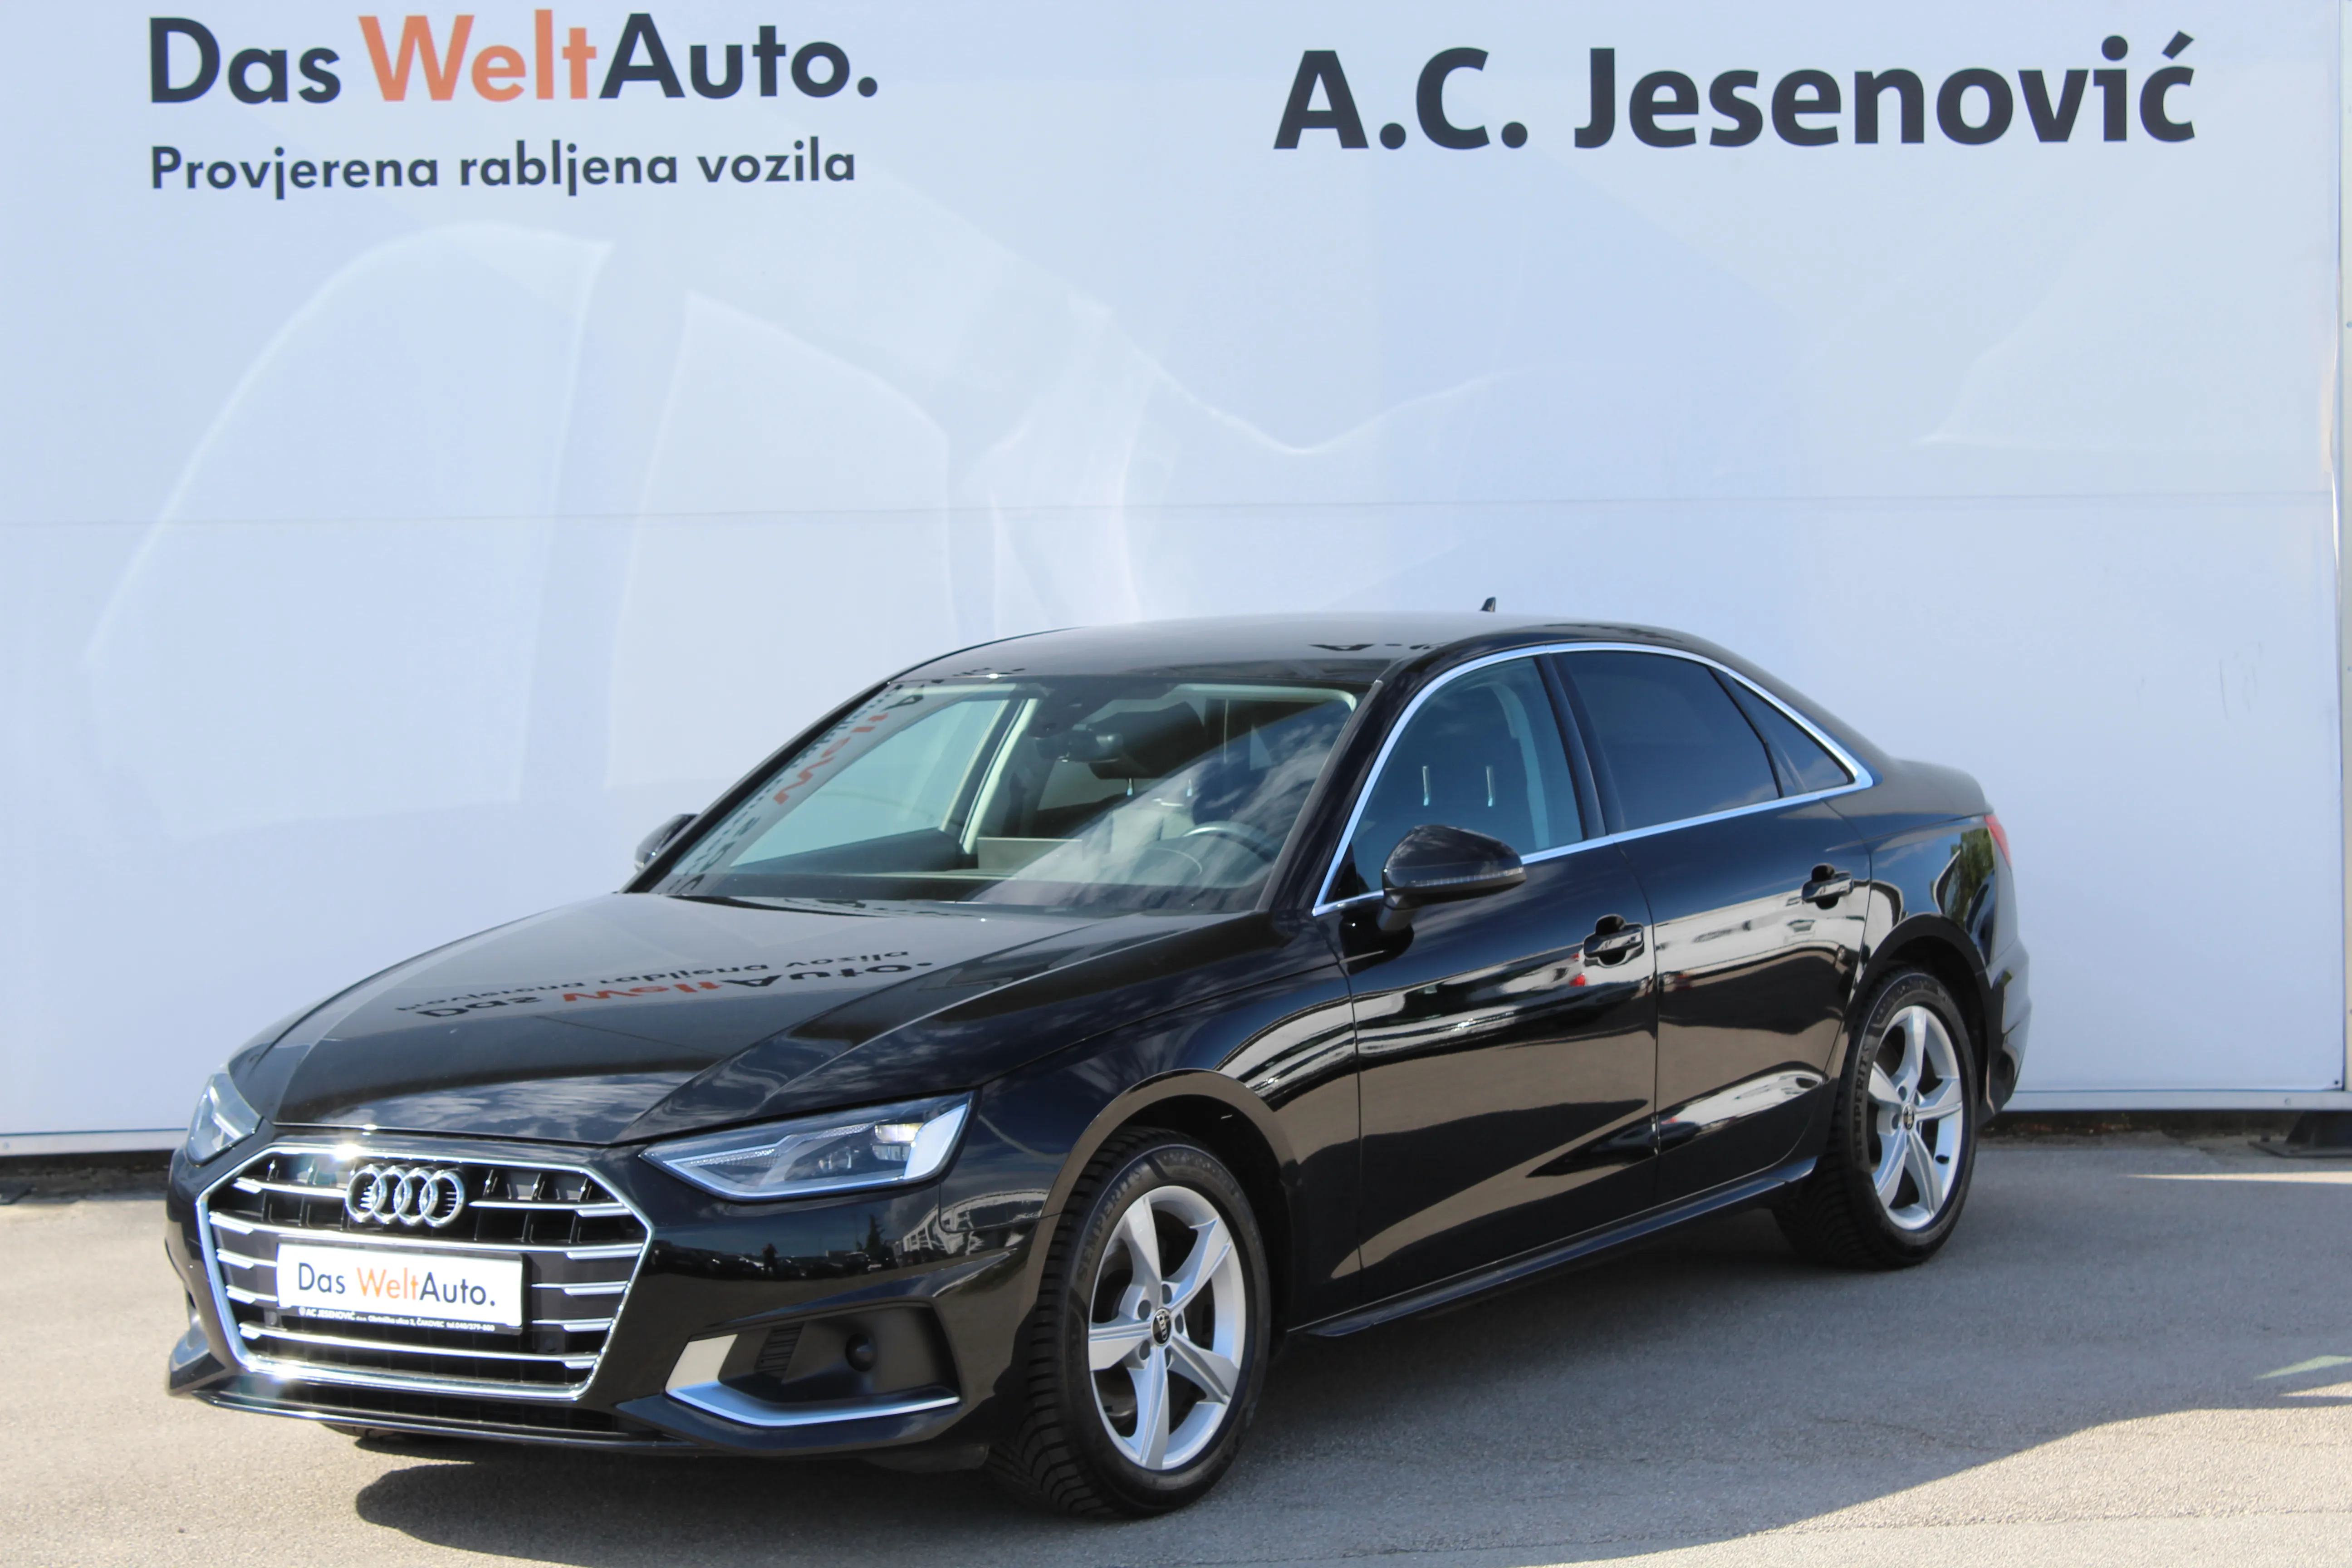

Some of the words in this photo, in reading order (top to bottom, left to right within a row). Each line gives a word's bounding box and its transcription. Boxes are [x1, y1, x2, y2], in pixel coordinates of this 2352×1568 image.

[149, 17, 341, 104] Das
[359, 10, 878, 100] WeltAuto.
[1274, 47, 1528, 150] A.C.
[1574, 30, 2195, 149] Jesenović
[152, 146, 438, 200] Provjerena
[461, 139, 677, 196] rabljena
[696, 136, 854, 183] vozila
[299, 1262, 345, 1294] Das
[357, 1267, 496, 1307] WeltAuto.
